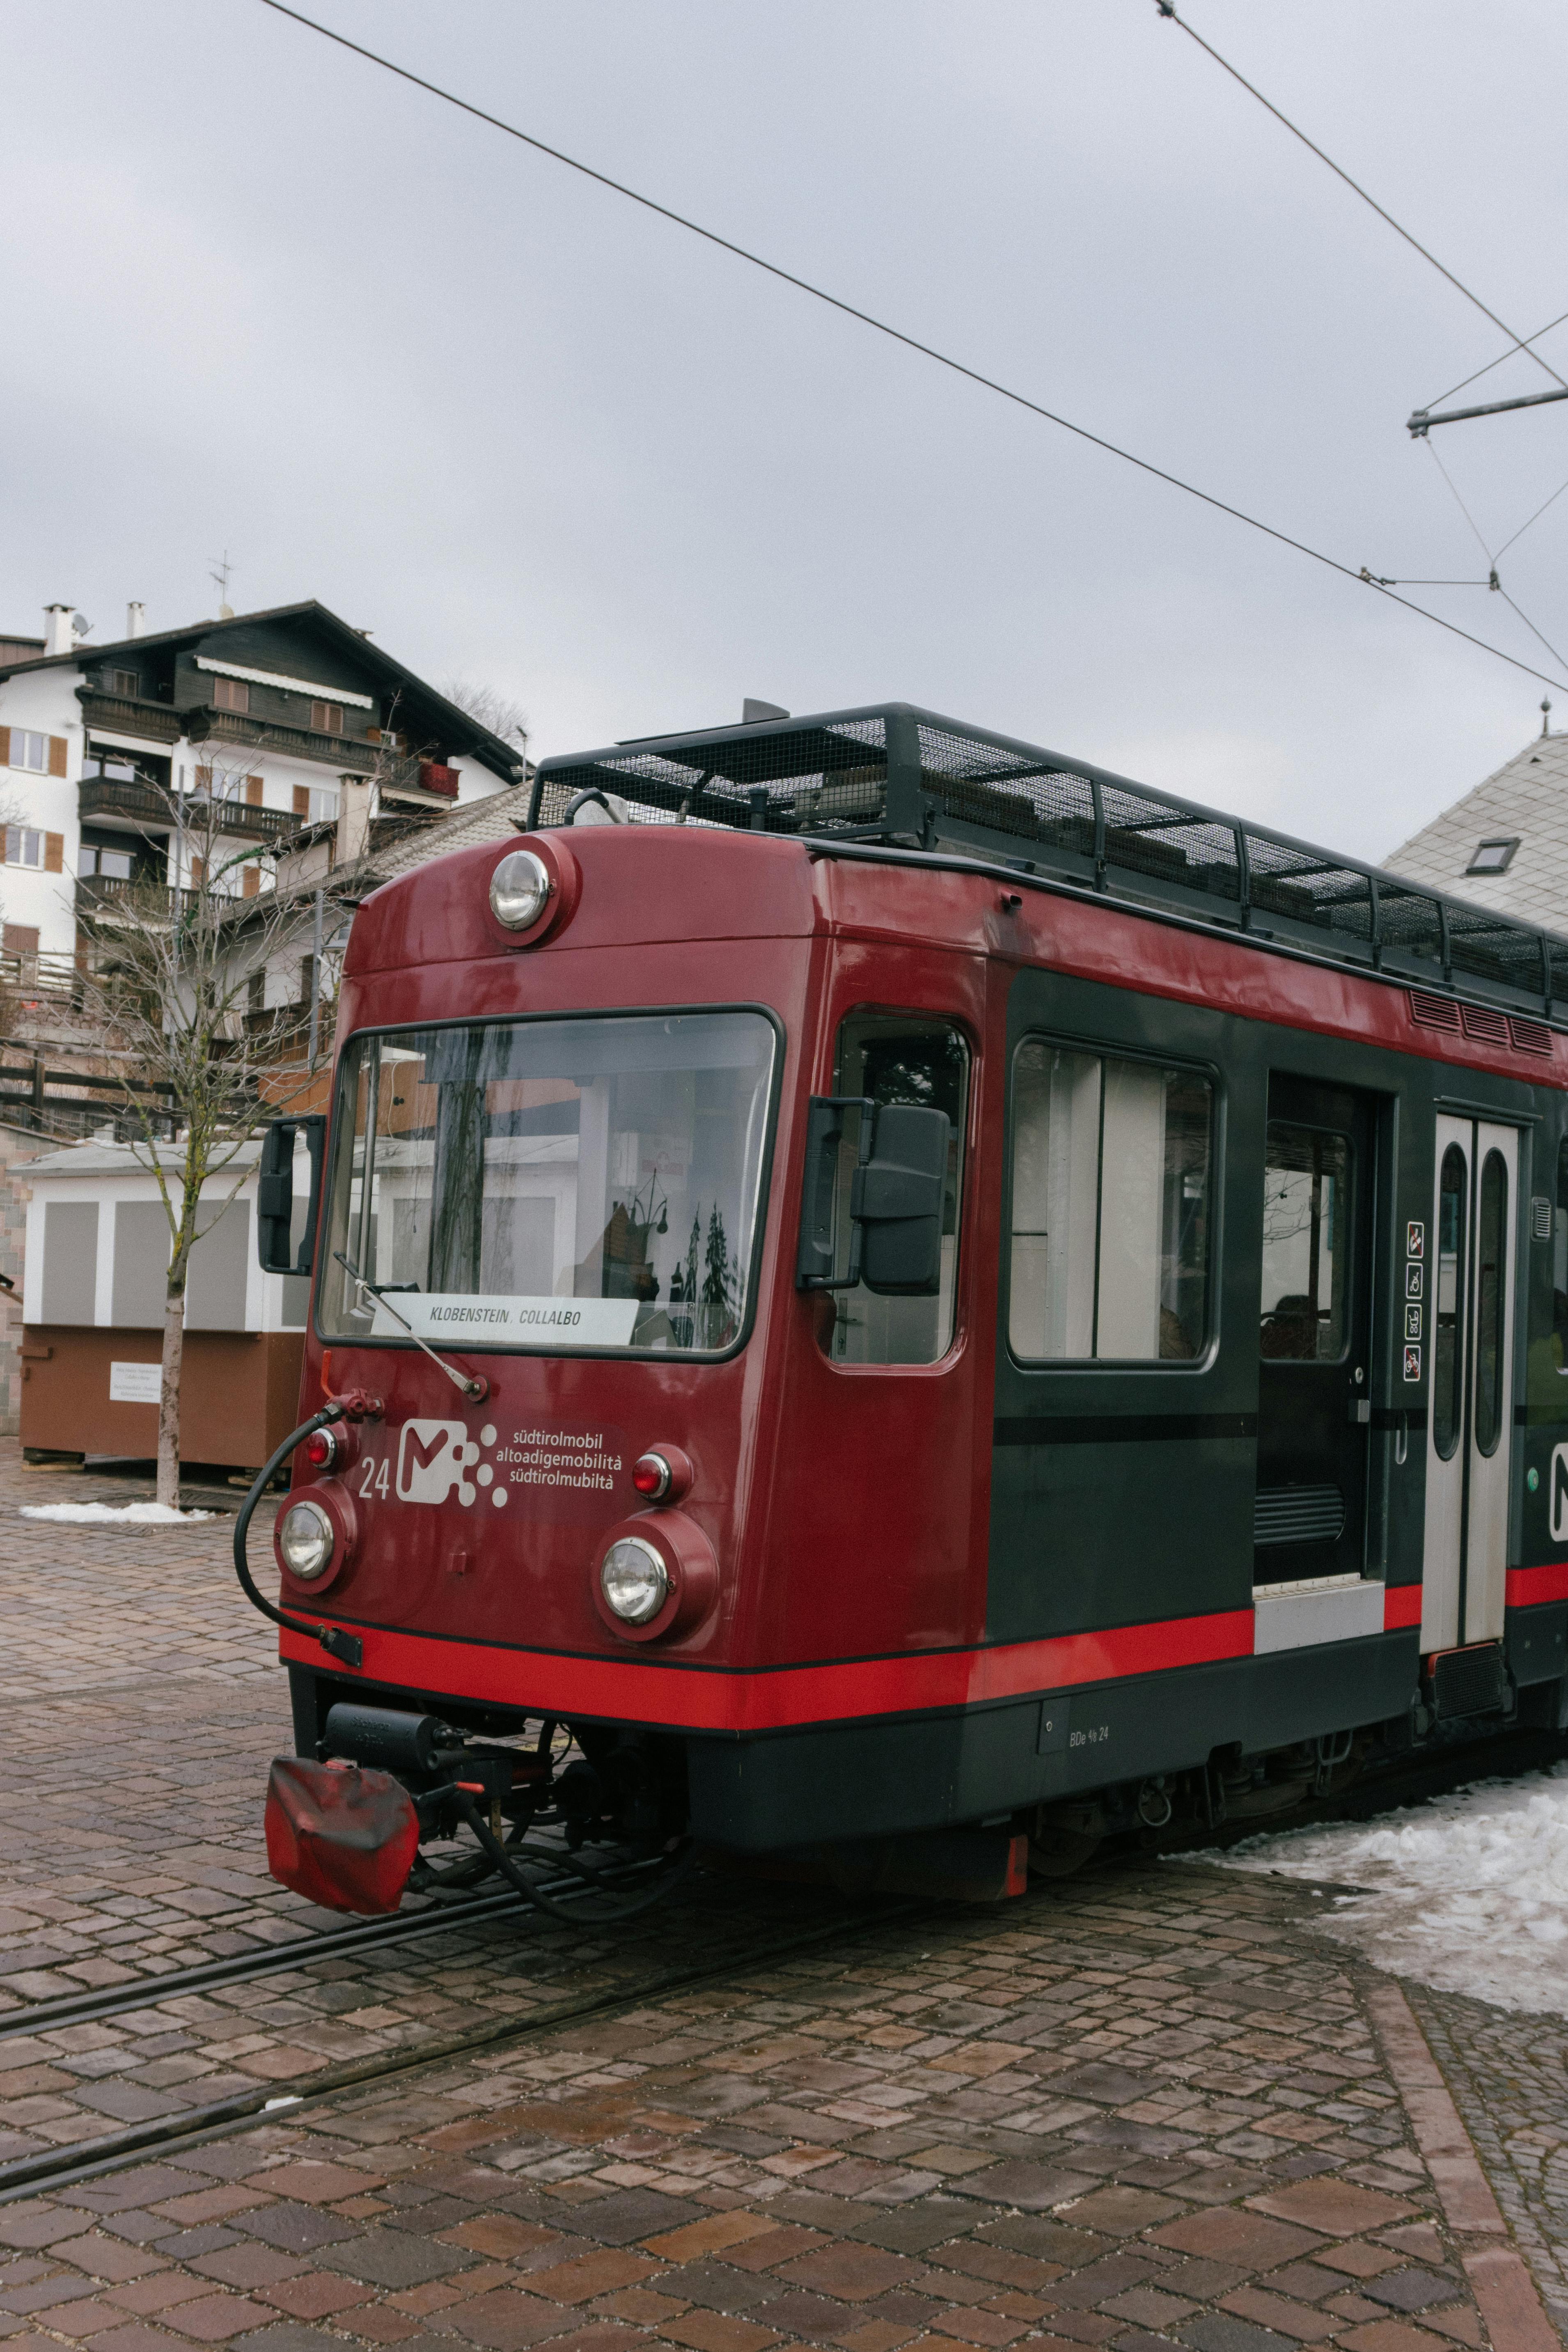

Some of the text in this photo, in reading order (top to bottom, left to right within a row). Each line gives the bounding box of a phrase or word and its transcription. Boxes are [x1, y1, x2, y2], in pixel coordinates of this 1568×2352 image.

[519, 1310, 581, 1325] COLLALBO
[513, 1430, 603, 1449] südtirolmobil
[496, 1447, 622, 1470] altoadigemobilità
[359, 1457, 389, 1499] 24
[510, 1468, 613, 1490] südtirolmubiltà
[1070, 1732, 1086, 1747] BDe
[1099, 1726, 1108, 1741] 24
